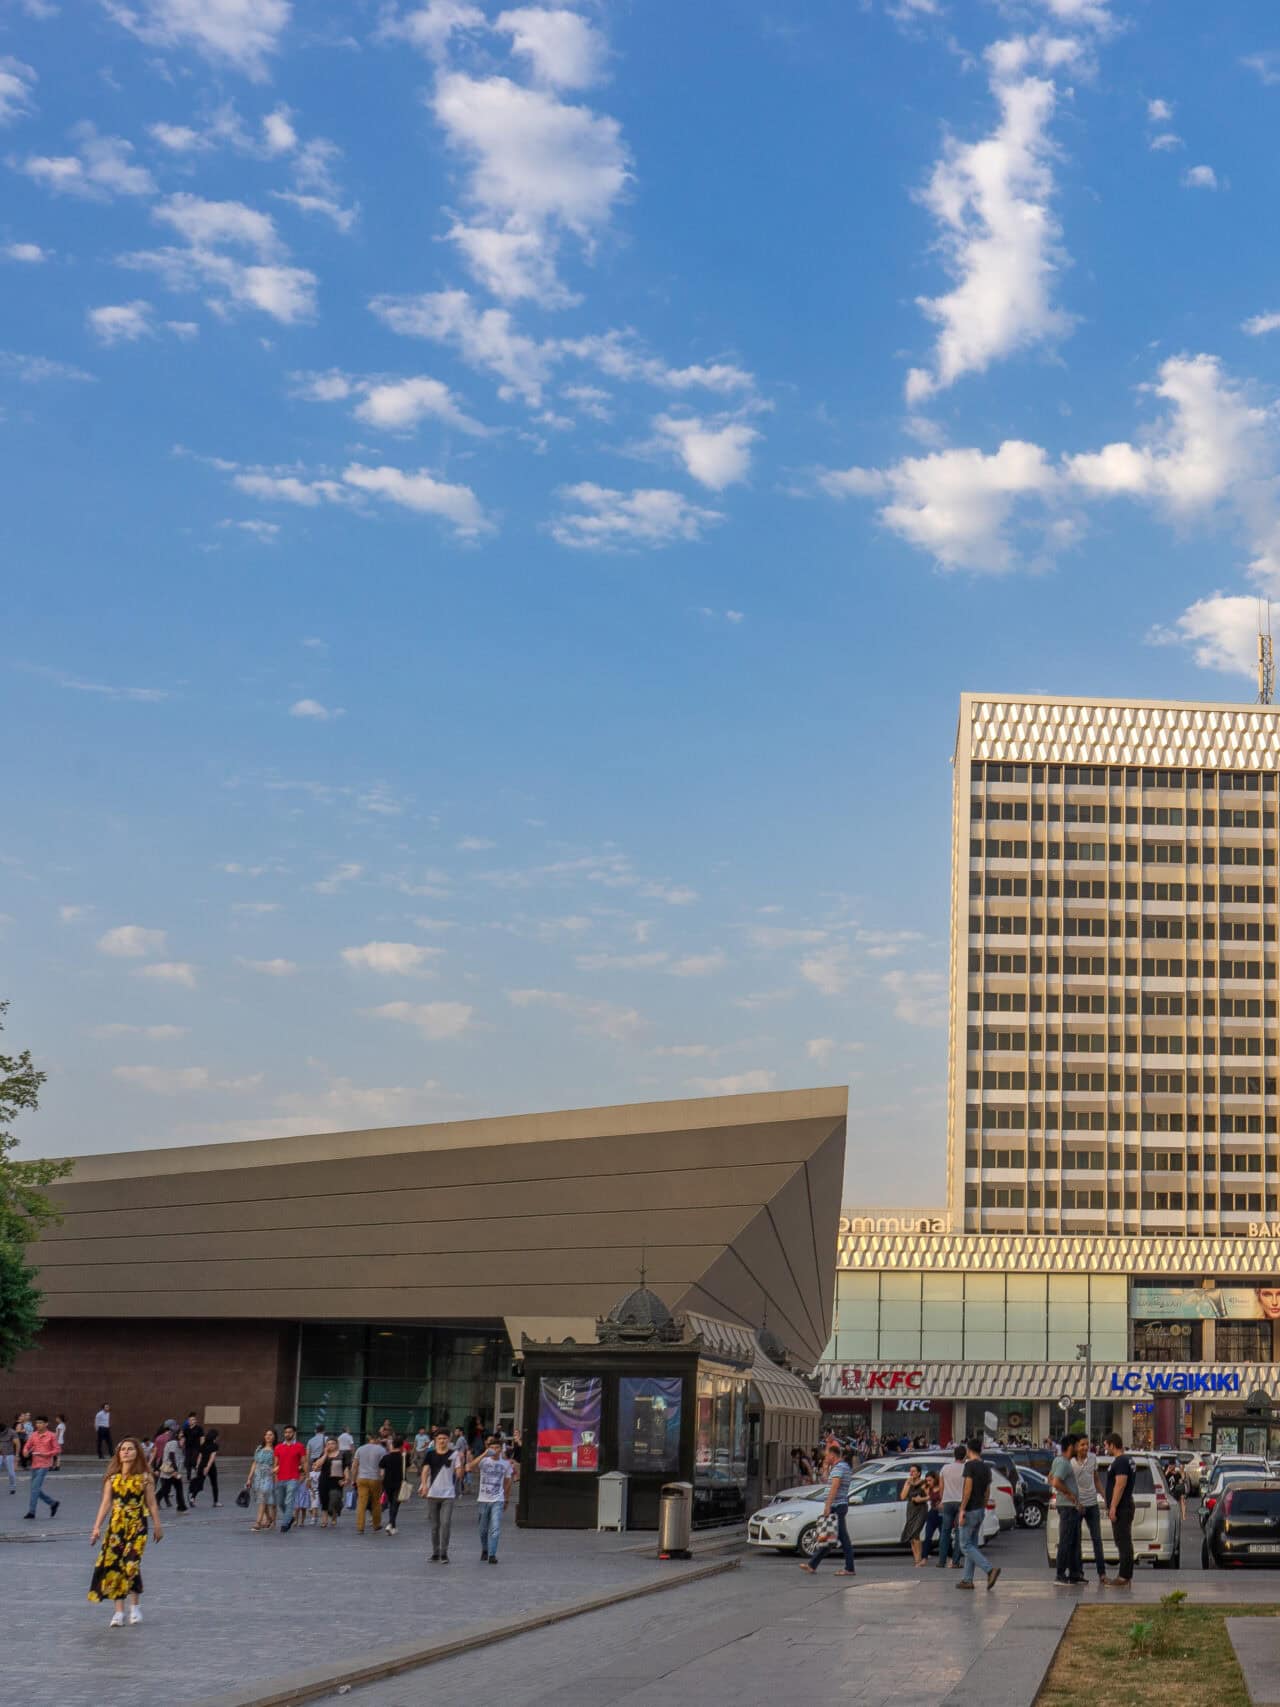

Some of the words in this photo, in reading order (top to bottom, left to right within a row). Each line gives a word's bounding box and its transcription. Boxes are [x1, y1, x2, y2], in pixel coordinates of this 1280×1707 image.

[866, 1371, 923, 1389] KFC
[1112, 1372, 1142, 1391] LC
[896, 1400, 931, 1411] KFC
